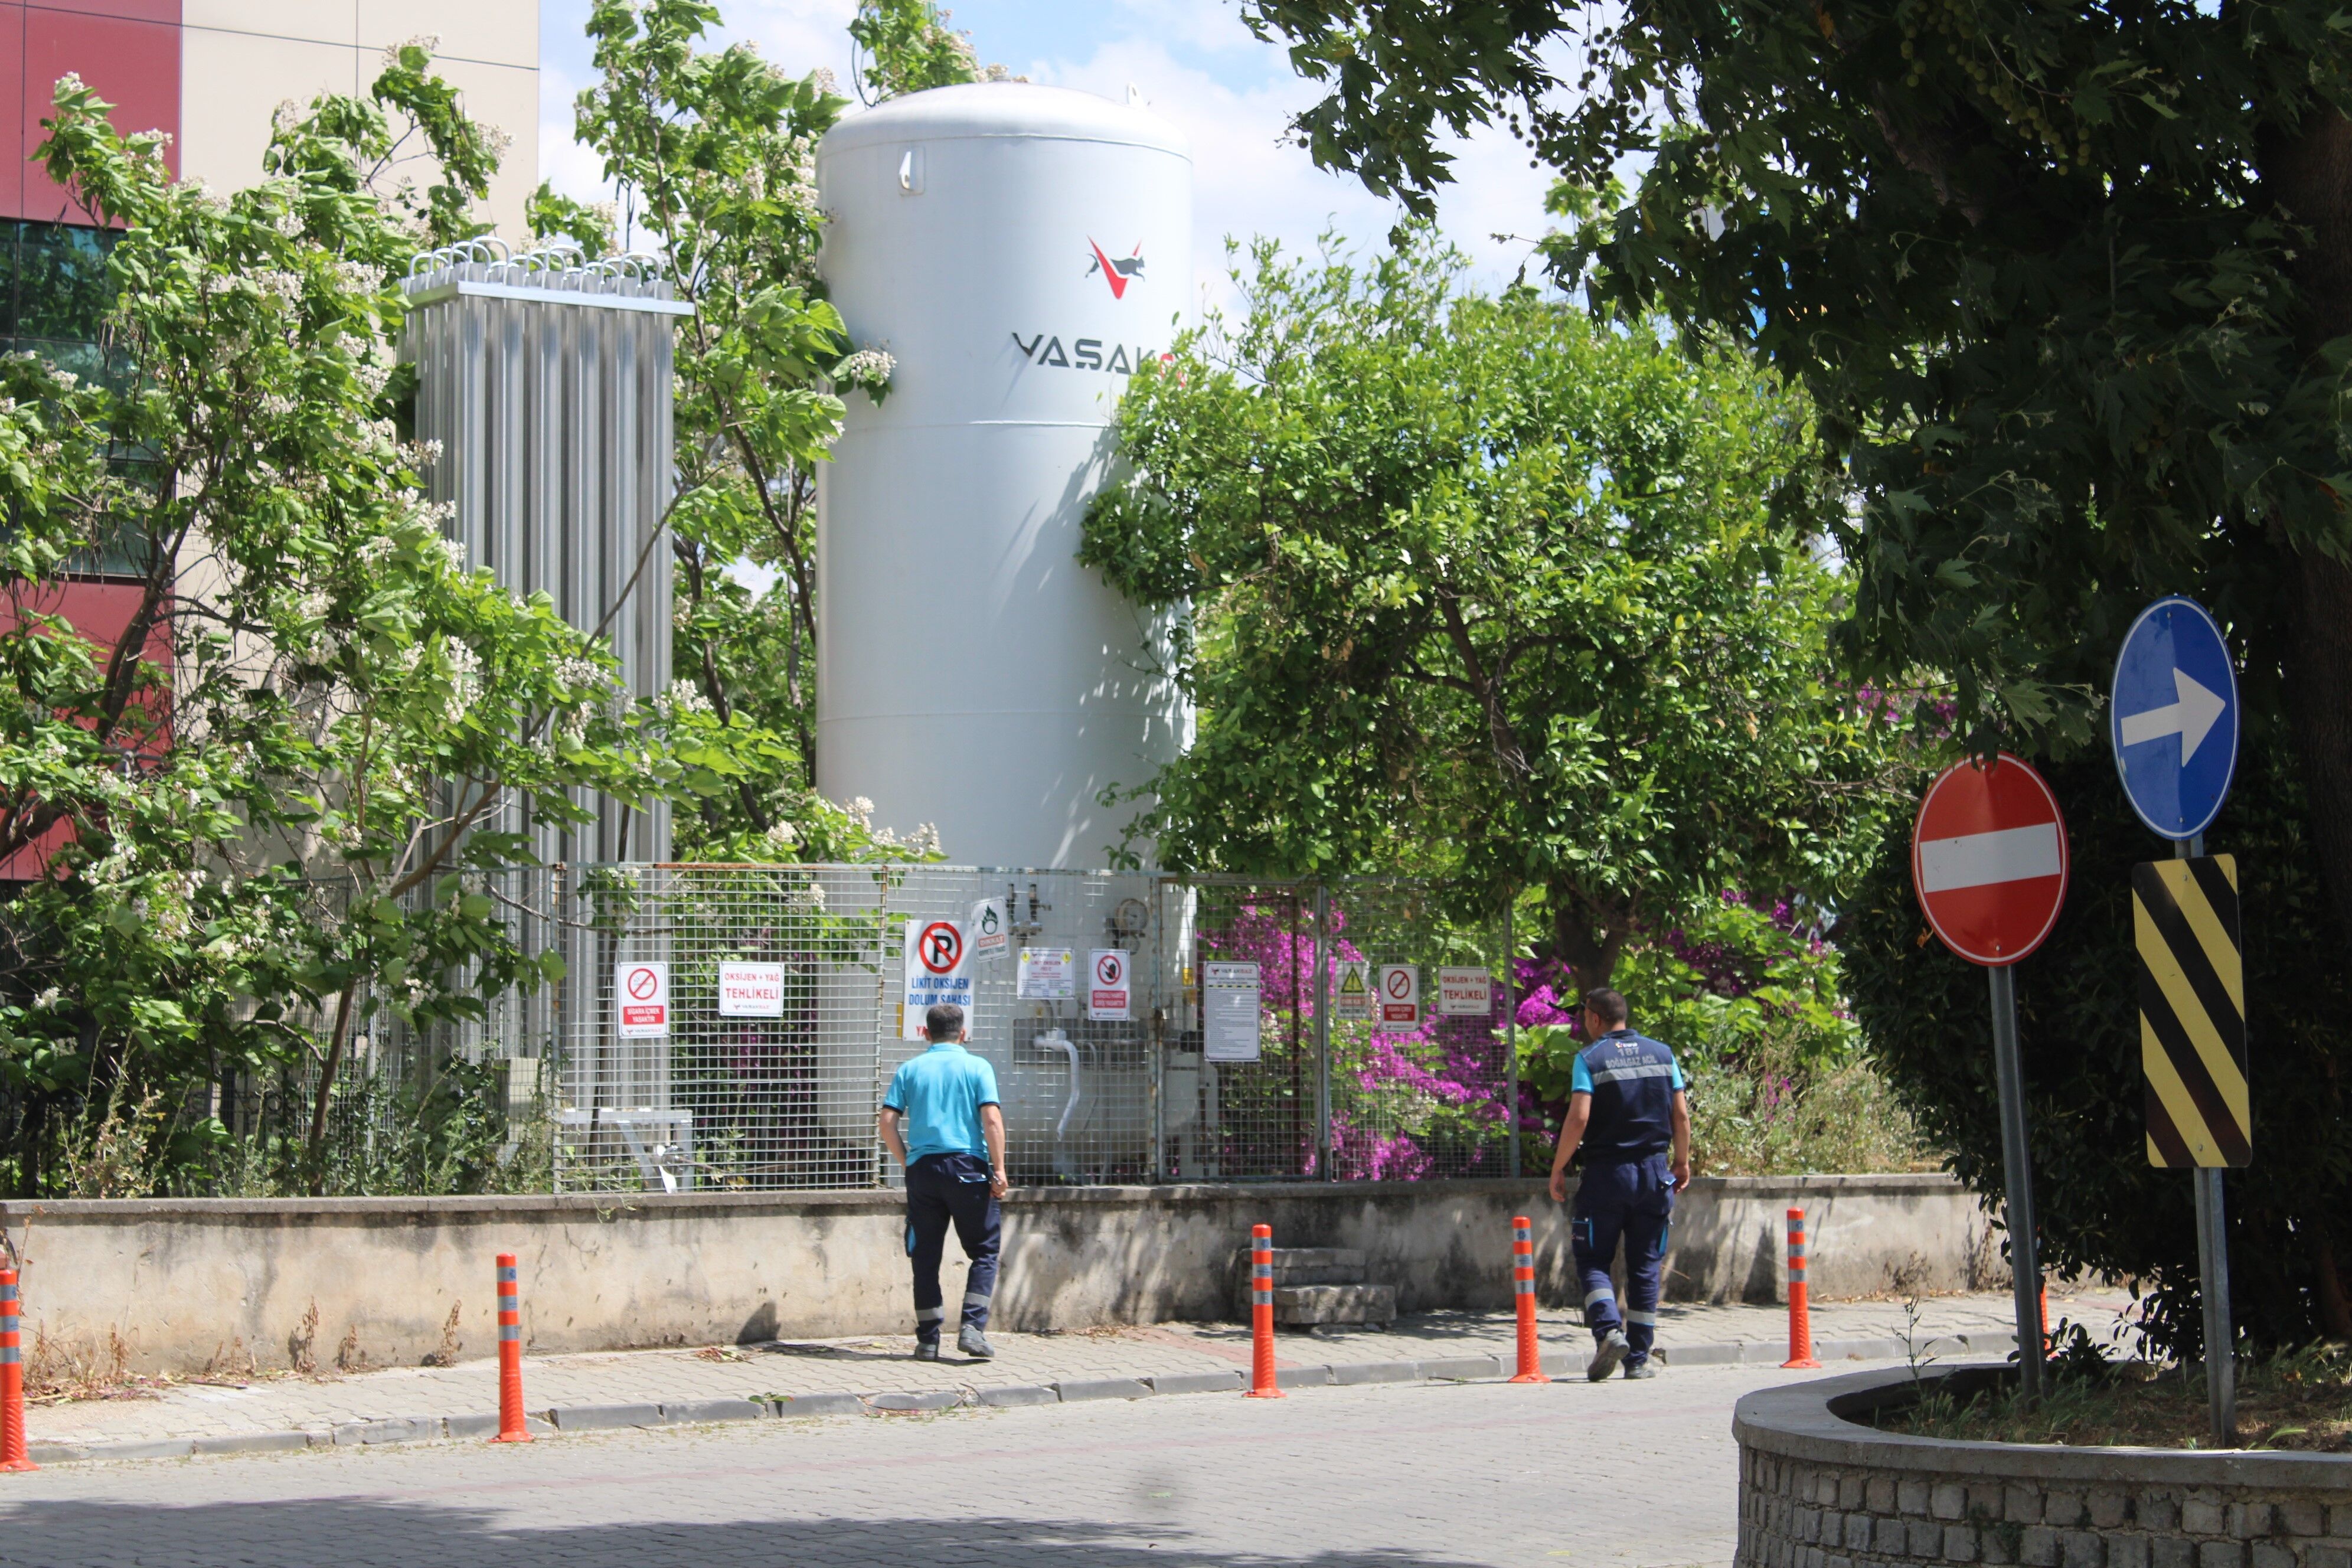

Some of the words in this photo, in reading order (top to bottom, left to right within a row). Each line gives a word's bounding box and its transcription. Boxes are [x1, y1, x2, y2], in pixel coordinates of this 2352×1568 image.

[724, 972, 757, 981] OKSİJEN
[765, 972, 780, 982] YAĞ
[912, 975, 931, 989] LİKİT
[934, 976, 969, 989] OKSİJEN
[726, 986, 779, 999] TEHLİKELİ
[1444, 988, 1487, 999] TEHLİKELİ
[909, 994, 937, 1005] DOLUM
[940, 994, 971, 1006] SAHASI
